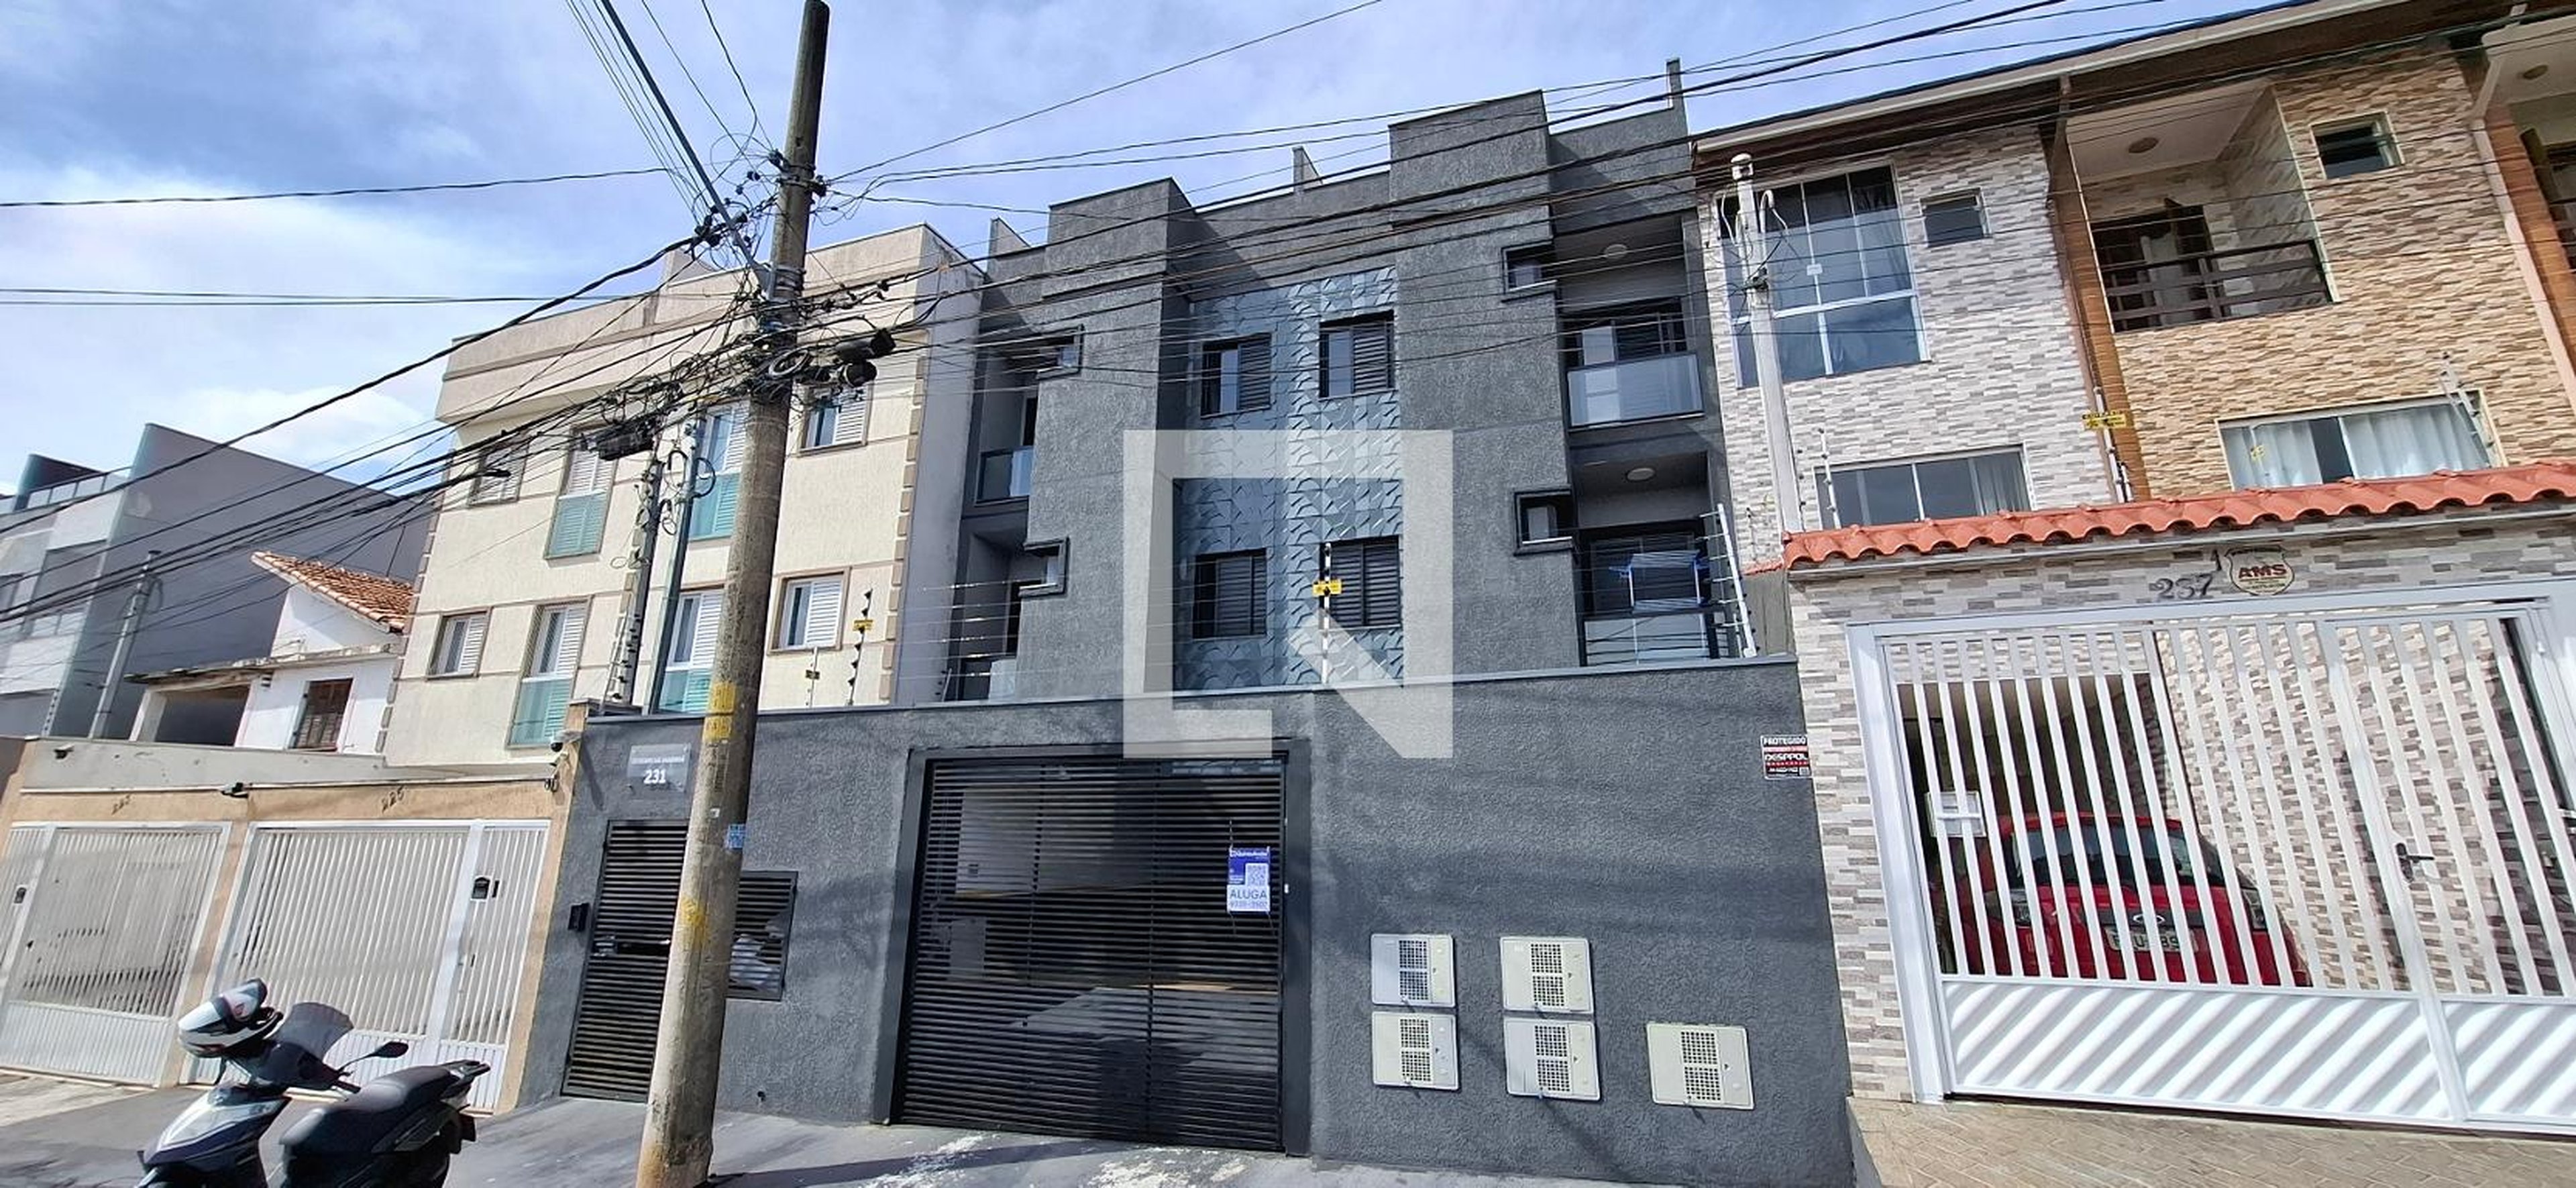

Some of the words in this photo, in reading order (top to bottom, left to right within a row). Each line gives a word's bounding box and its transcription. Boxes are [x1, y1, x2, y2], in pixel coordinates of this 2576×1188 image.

[2239, 564, 2287, 578] AMS
[644, 769, 666, 784] 231
[1230, 889, 1267, 900] ALUGA
